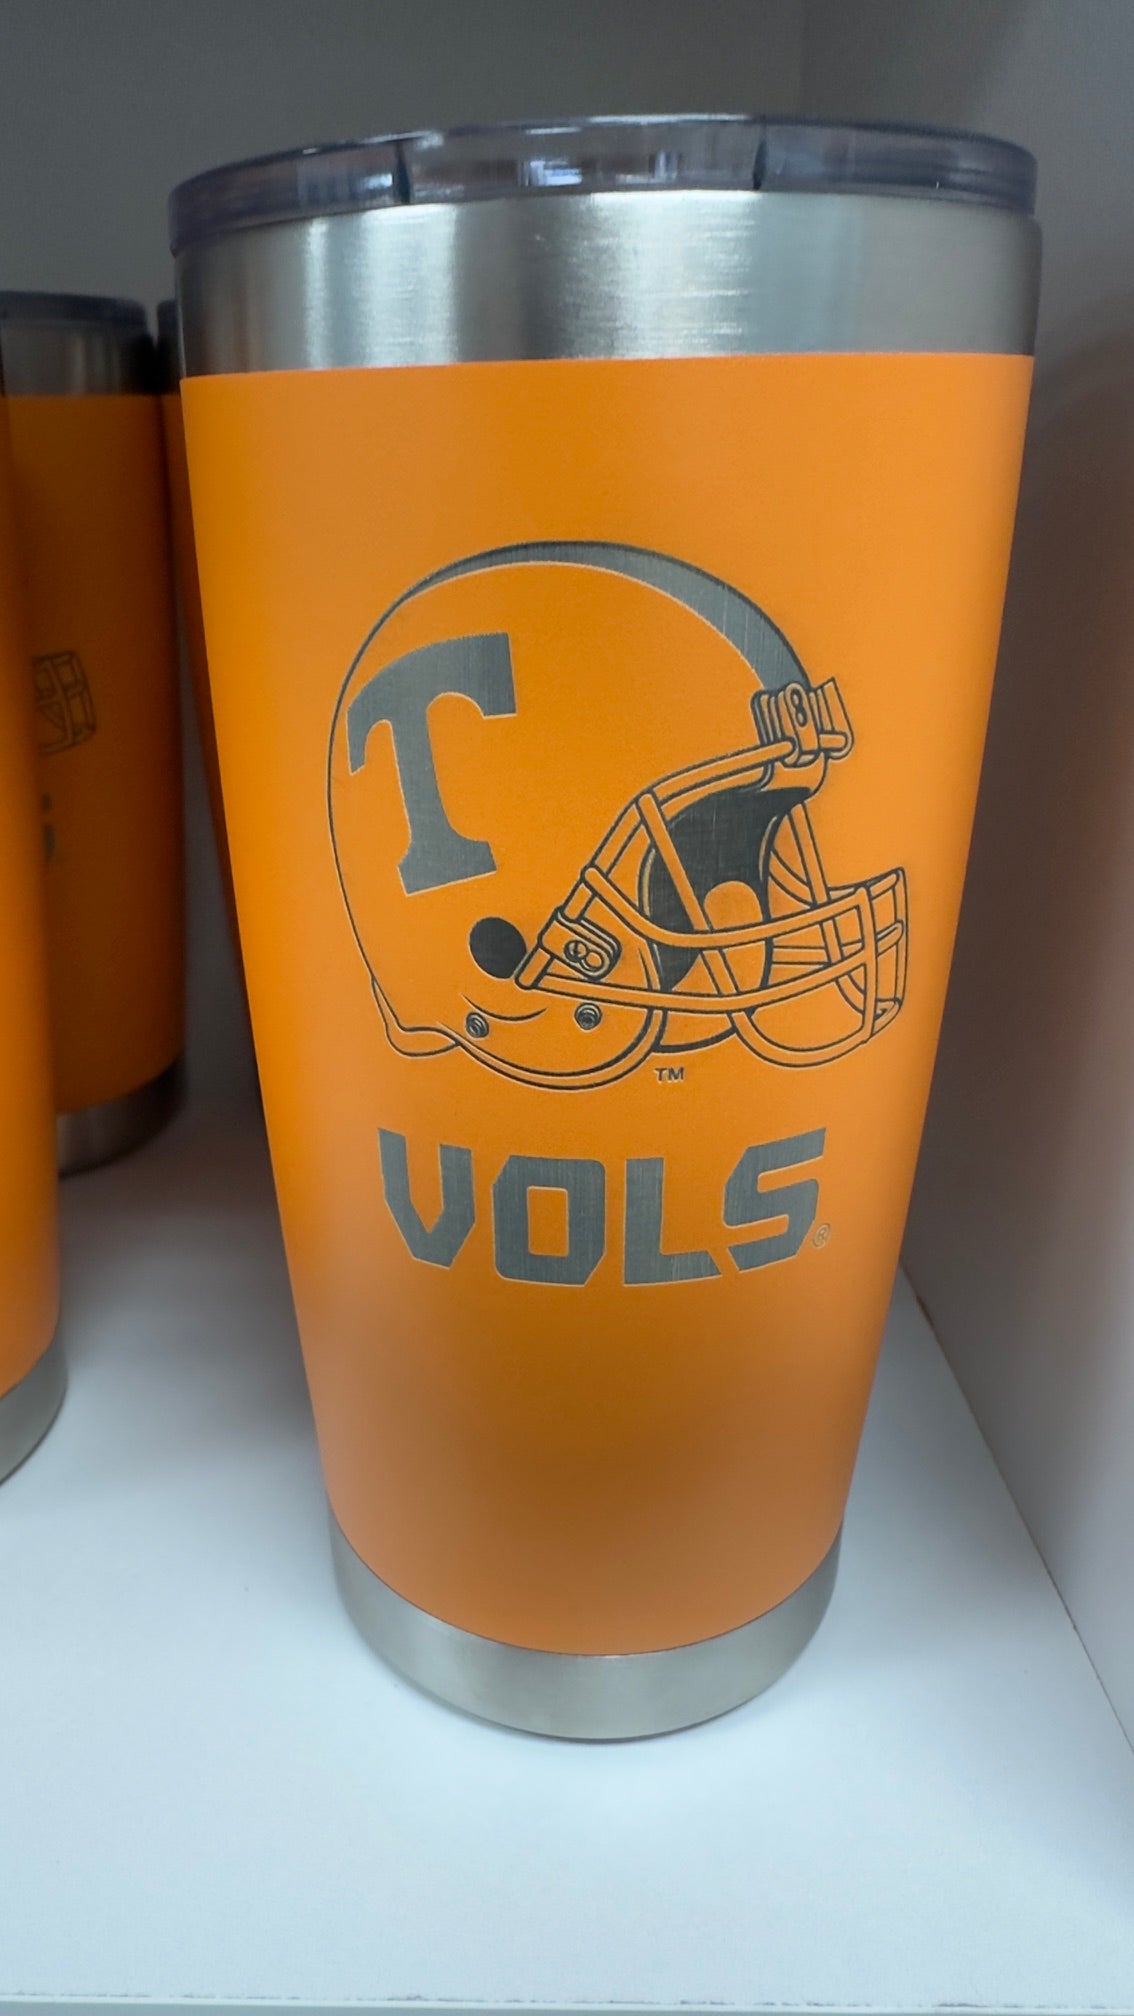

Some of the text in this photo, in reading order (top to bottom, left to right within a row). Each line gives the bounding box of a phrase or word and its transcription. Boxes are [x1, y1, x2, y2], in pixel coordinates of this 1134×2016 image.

[347, 632, 517, 896] T
[655, 1067, 686, 1083] TM
[377, 1127, 826, 1286] VOLS
